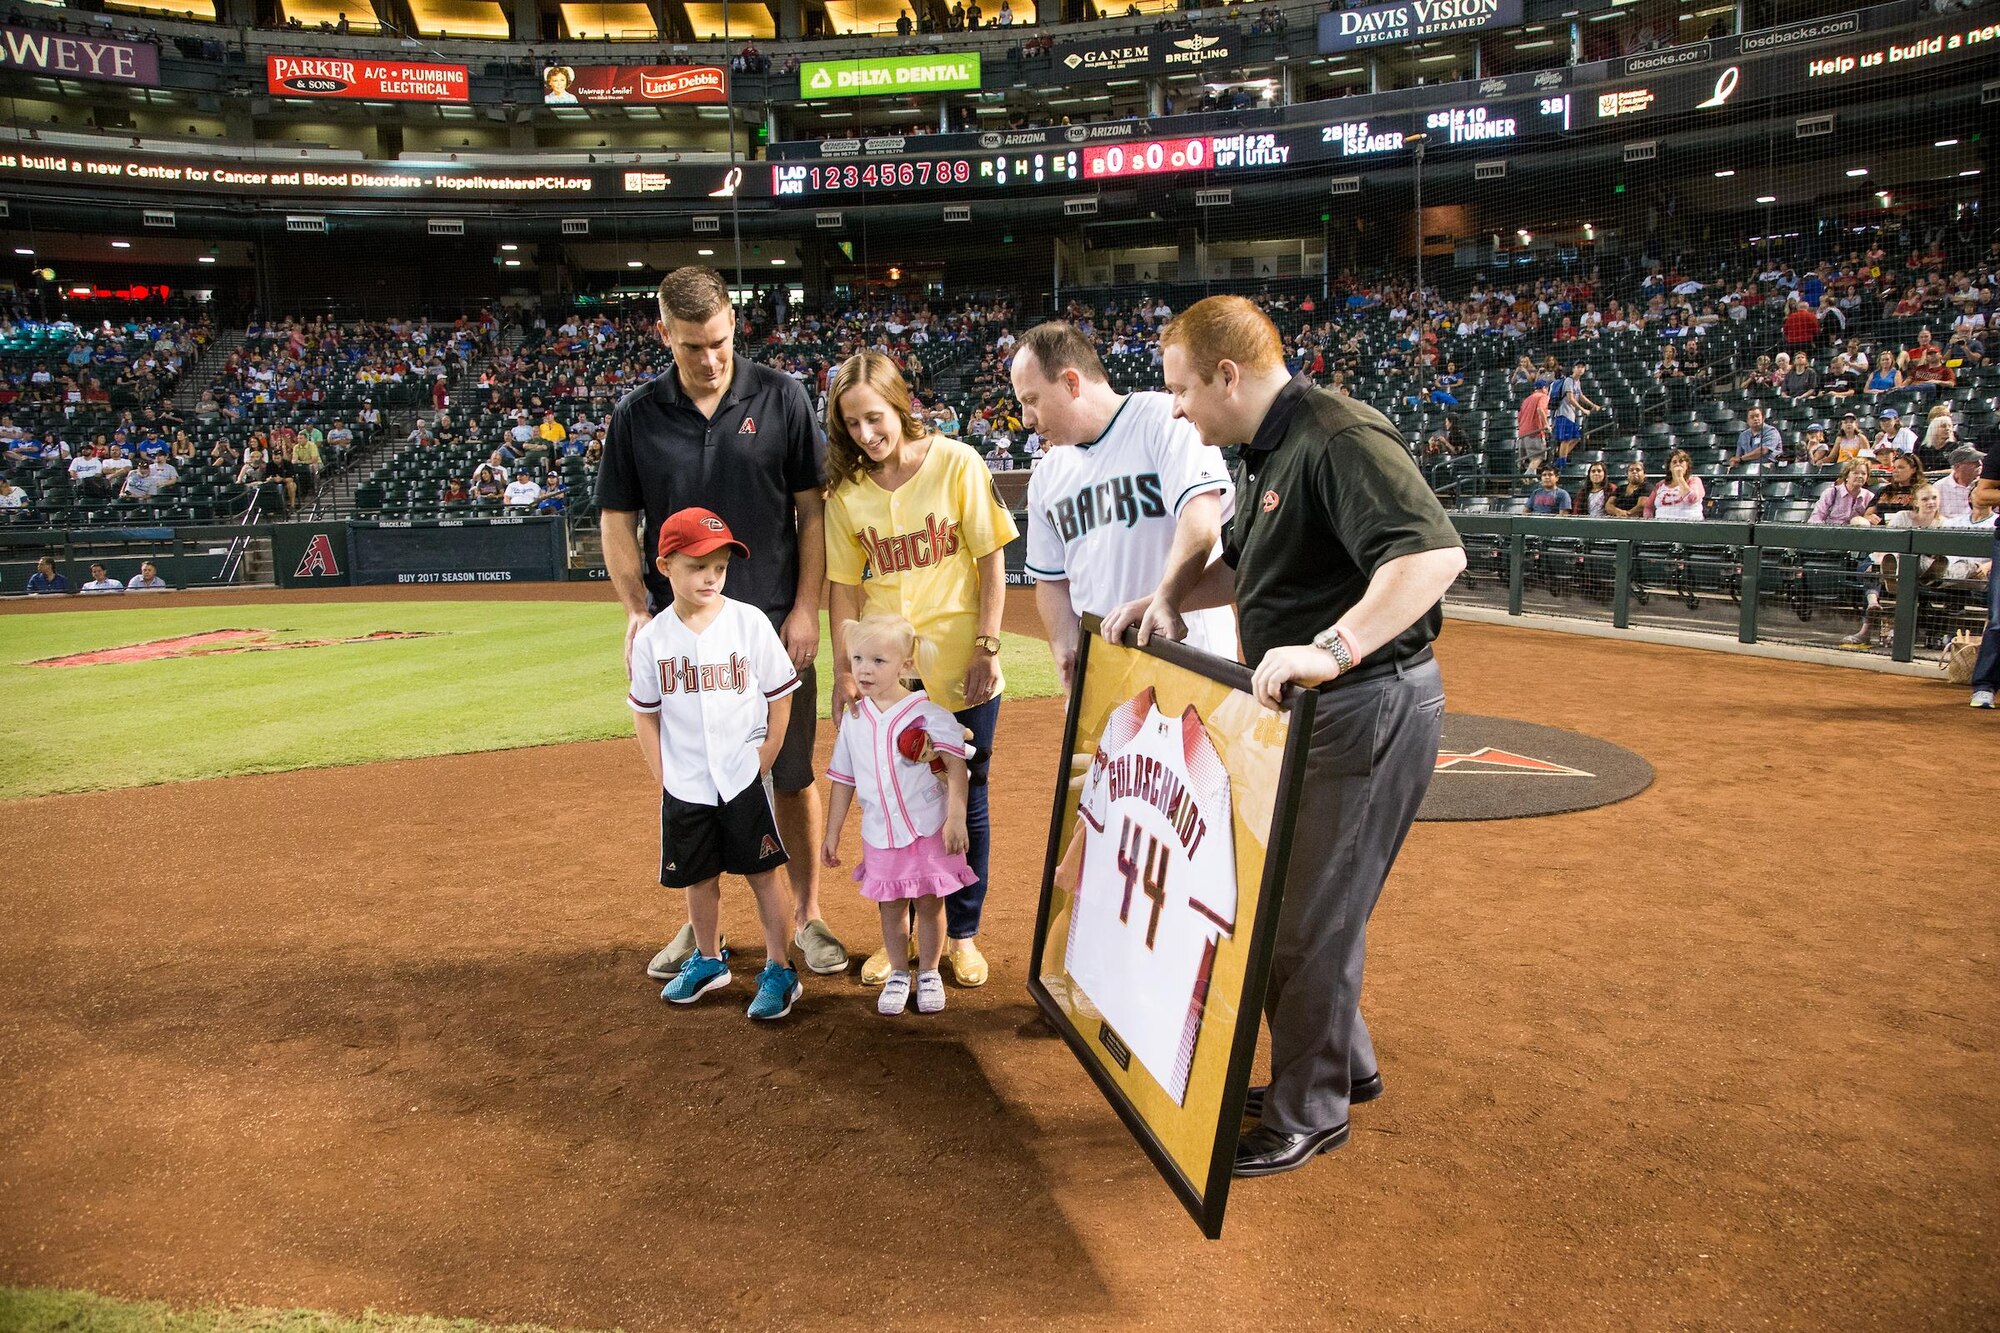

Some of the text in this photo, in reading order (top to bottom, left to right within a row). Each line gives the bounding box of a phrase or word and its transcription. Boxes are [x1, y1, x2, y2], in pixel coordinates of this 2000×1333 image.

[1340, 0, 1498, 35] DAVIS VISION
[1356, 16, 1486, 44] EYECARE REFRAMED
[1745, 20, 1853, 49] losdbacks.com
[0, 31, 136, 78] WEYE
[1084, 46, 1149, 61] GANEM
[1165, 48, 1228, 63] BREITLING
[1809, 54, 1855, 77] Help
[1860, 51, 1885, 68] us
[1889, 35, 1944, 62] build
[1947, 34, 1962, 49] a
[274, 58, 356, 84] PARKER
[364, 68, 464, 83] A/C PLUMBING
[837, 64, 969, 87] DELTA DENTAL
[297, 80, 336, 89] & SONS
[381, 81, 449, 95] ELECTRICAL
[646, 72, 718, 94] Little Debbie
[1540, 98, 1563, 115] 3B
[1427, 113, 1449, 128] SS
[1090, 125, 1131, 137] ARIZONA
[1322, 126, 1342, 142] 2B
[1455, 119, 1515, 142] TURNER
[1005, 133, 1046, 144] ARIZONA
[1213, 138, 1240, 152] DUE
[1348, 132, 1403, 154] SEAGER
[1035, 154, 1043, 167] 0
[1067, 151, 1077, 165] 0
[1093, 158, 1105, 173] B
[1107, 147, 1123, 172] 0
[1132, 155, 1144, 169] S
[1146, 143, 1164, 169] 0
[1186, 141, 1204, 166] 0
[1217, 151, 1236, 166] UP
[1246, 146, 1289, 165] UTLEY
[981, 161, 993, 176] R
[997, 157, 1006, 170] 0
[1015, 160, 1028, 175] H
[1053, 156, 1065, 171] E
[0, 157, 16, 167] us
[21, 155, 66, 171] build
[72, 162, 82, 172] a
[87, 162, 122, 176] new
[126, 163, 181, 180] Center
[185, 167, 209, 182] for
[213, 170, 268, 185] Cancer
[271, 172, 299, 186] and
[303, 173, 347, 186] Blood
[351, 173, 421, 187] Disorders
[436, 175, 591, 191] HopelivesherePCH.org
[780, 167, 806, 180] LAD
[810, 160, 969, 189] 1 2 3 4 5 6 7 8 9
[997, 171, 1006, 184] 0
[1035, 168, 1043, 182] 0
[1068, 165, 1077, 179] 0
[780, 181, 802, 193] ARI
[398, 571, 511, 583] BUY 2017 SEASON TICKETS
[588, 569, 609, 577] CH
[1005, 573, 1037, 584] SON TIC
[1108, 753, 1206, 862] GOLDSCHMIDT
[1118, 814, 1170, 953] 44
